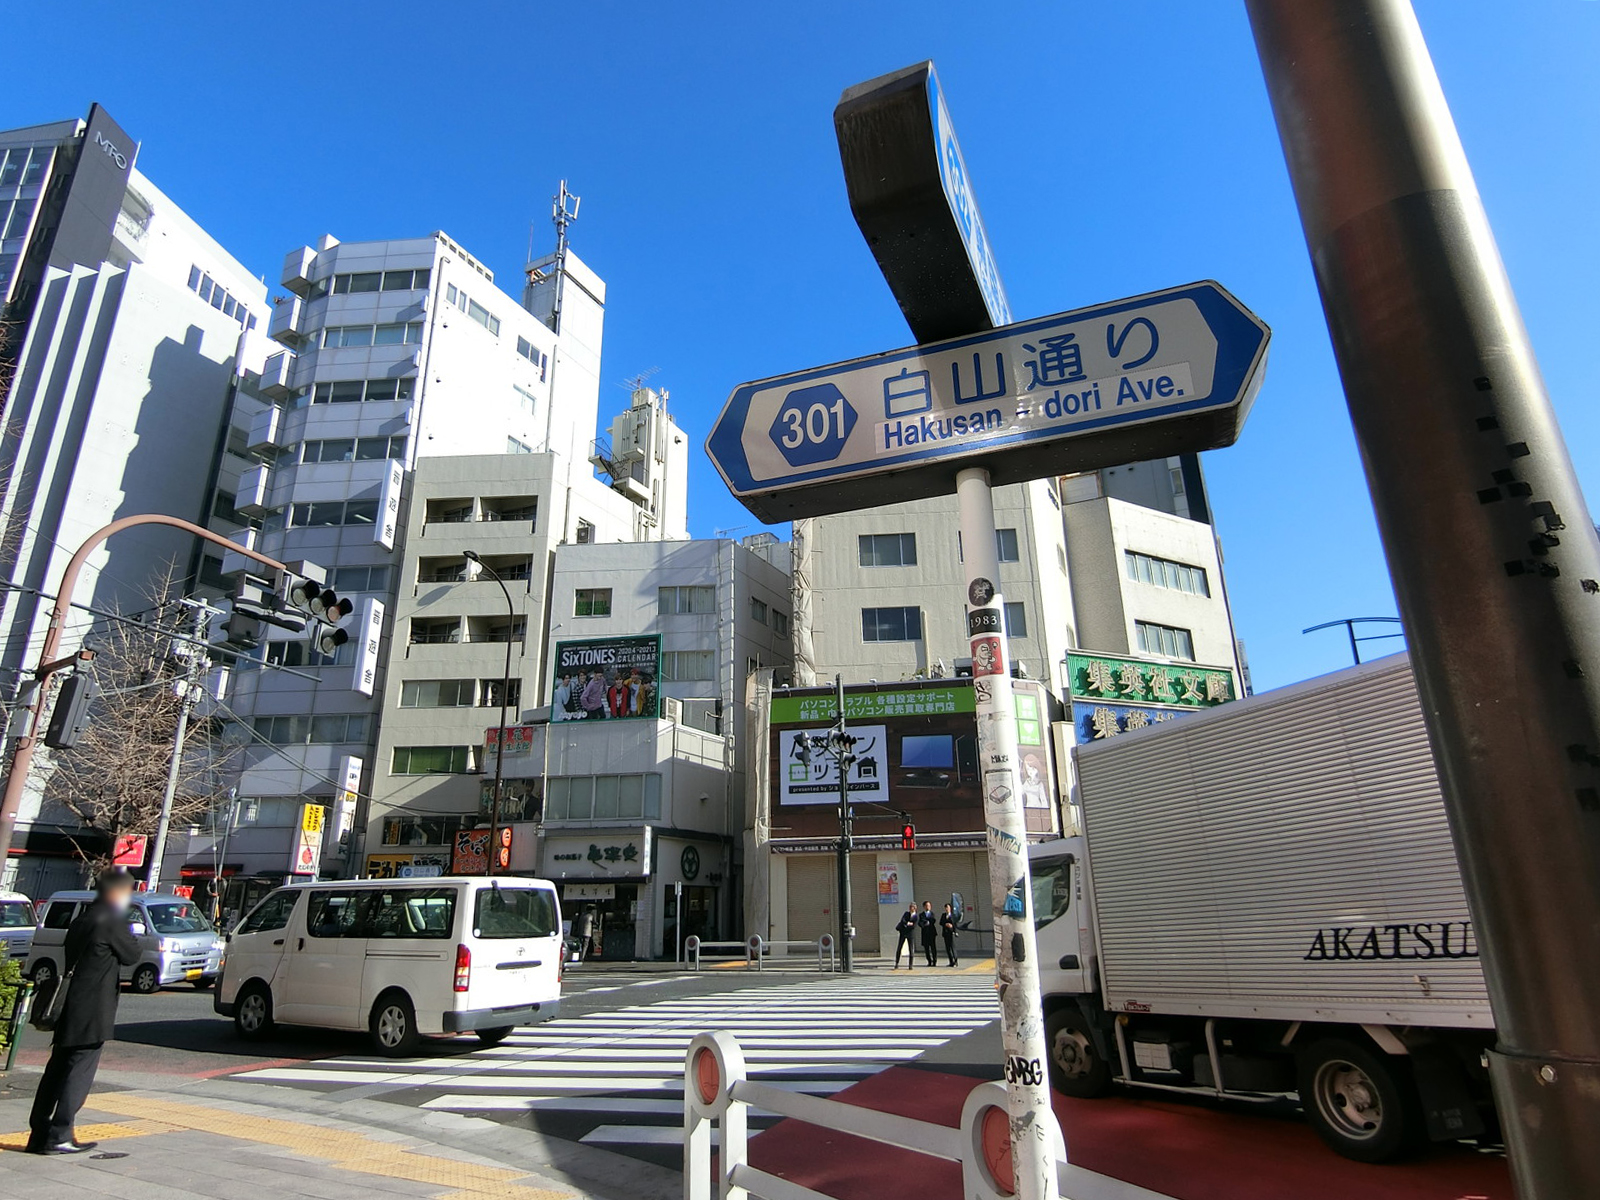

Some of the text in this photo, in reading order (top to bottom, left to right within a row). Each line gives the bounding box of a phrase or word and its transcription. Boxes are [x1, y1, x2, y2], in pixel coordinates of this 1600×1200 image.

[780, 316, 1161, 450] 301 白山通り
[883, 408, 1001, 449] Hakusan
[1045, 382, 1101, 419] dori
[1116, 374, 1186, 406] Ave.
[970, 615, 998, 629] 1983
[561, 648, 616, 667] SixTONES
[617, 654, 657, 663] CALENDAR
[1086, 660, 1232, 703] 集英社文庫
[799, 697, 873, 710] パソコンラブル
